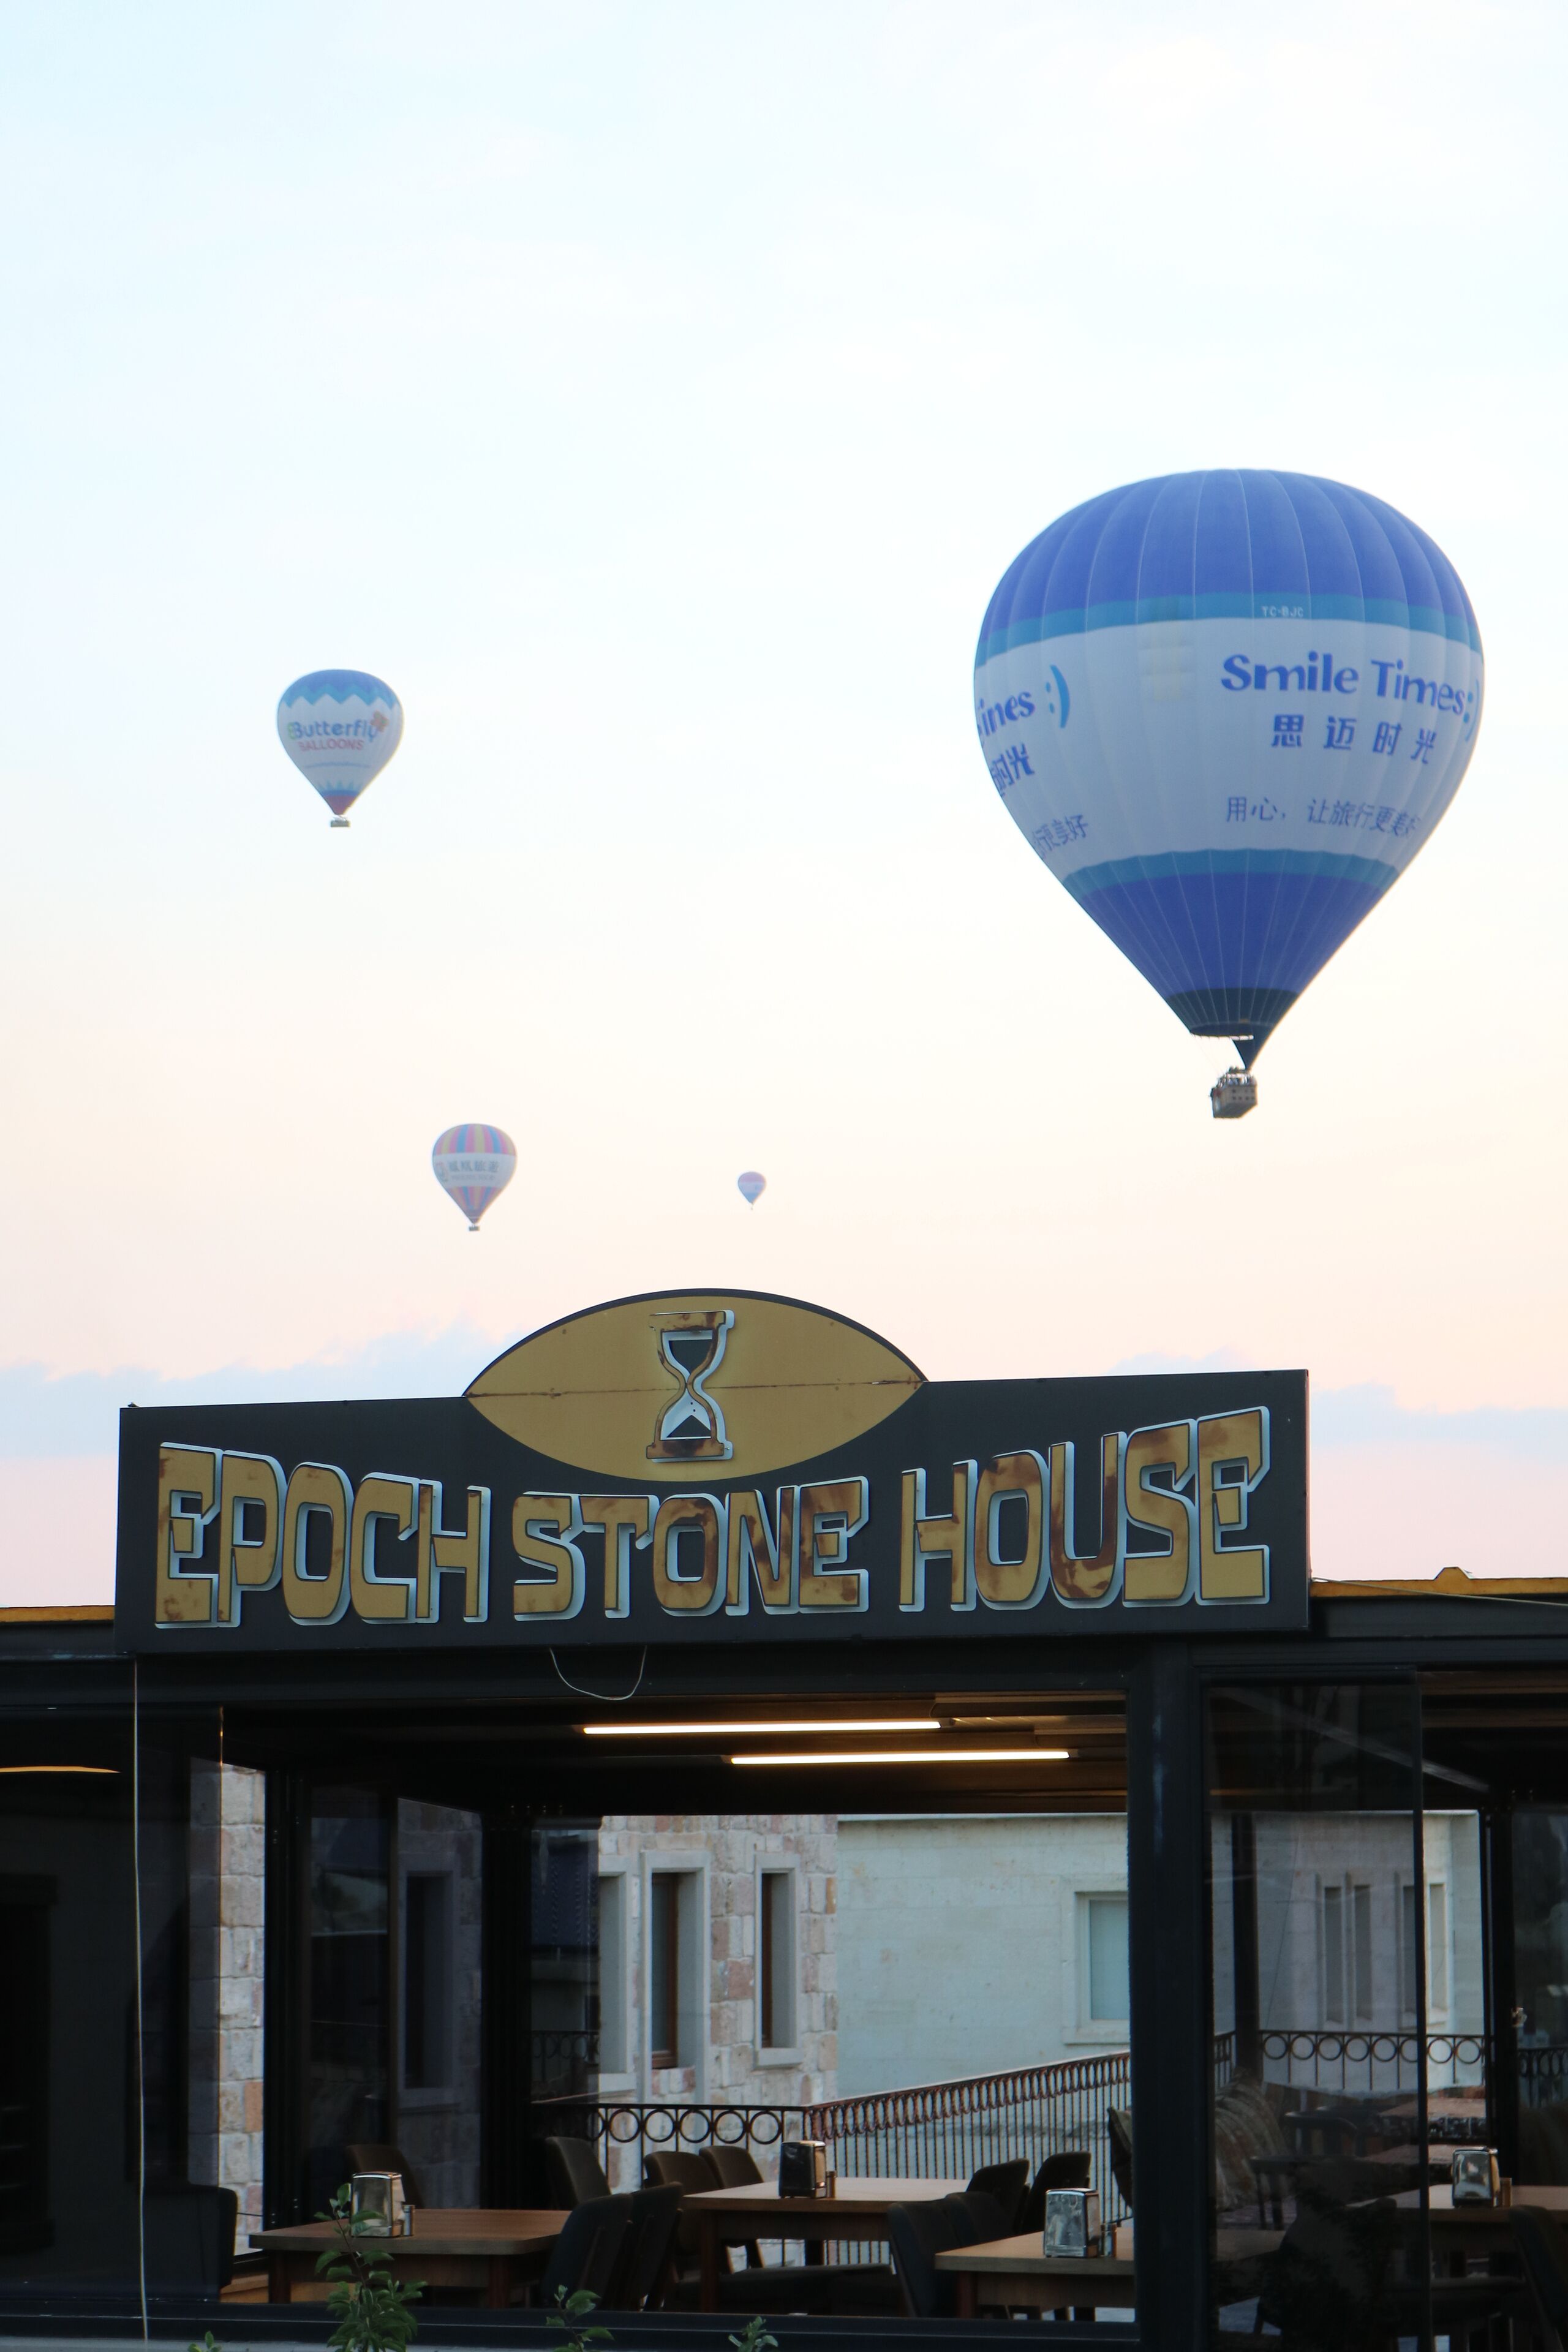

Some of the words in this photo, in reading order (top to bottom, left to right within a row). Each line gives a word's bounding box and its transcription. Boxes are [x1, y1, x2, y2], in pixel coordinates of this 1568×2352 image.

[1221, 650, 1360, 694] Smile
[294, 719, 379, 742] Butterfly
[298, 738, 364, 752] BALLOONS
[1271, 714, 1437, 764] 思迈时光
[154, 1441, 491, 1629] EPOCH
[511, 1475, 869, 1622] STONE
[899, 1406, 1270, 1612] HOUSE
